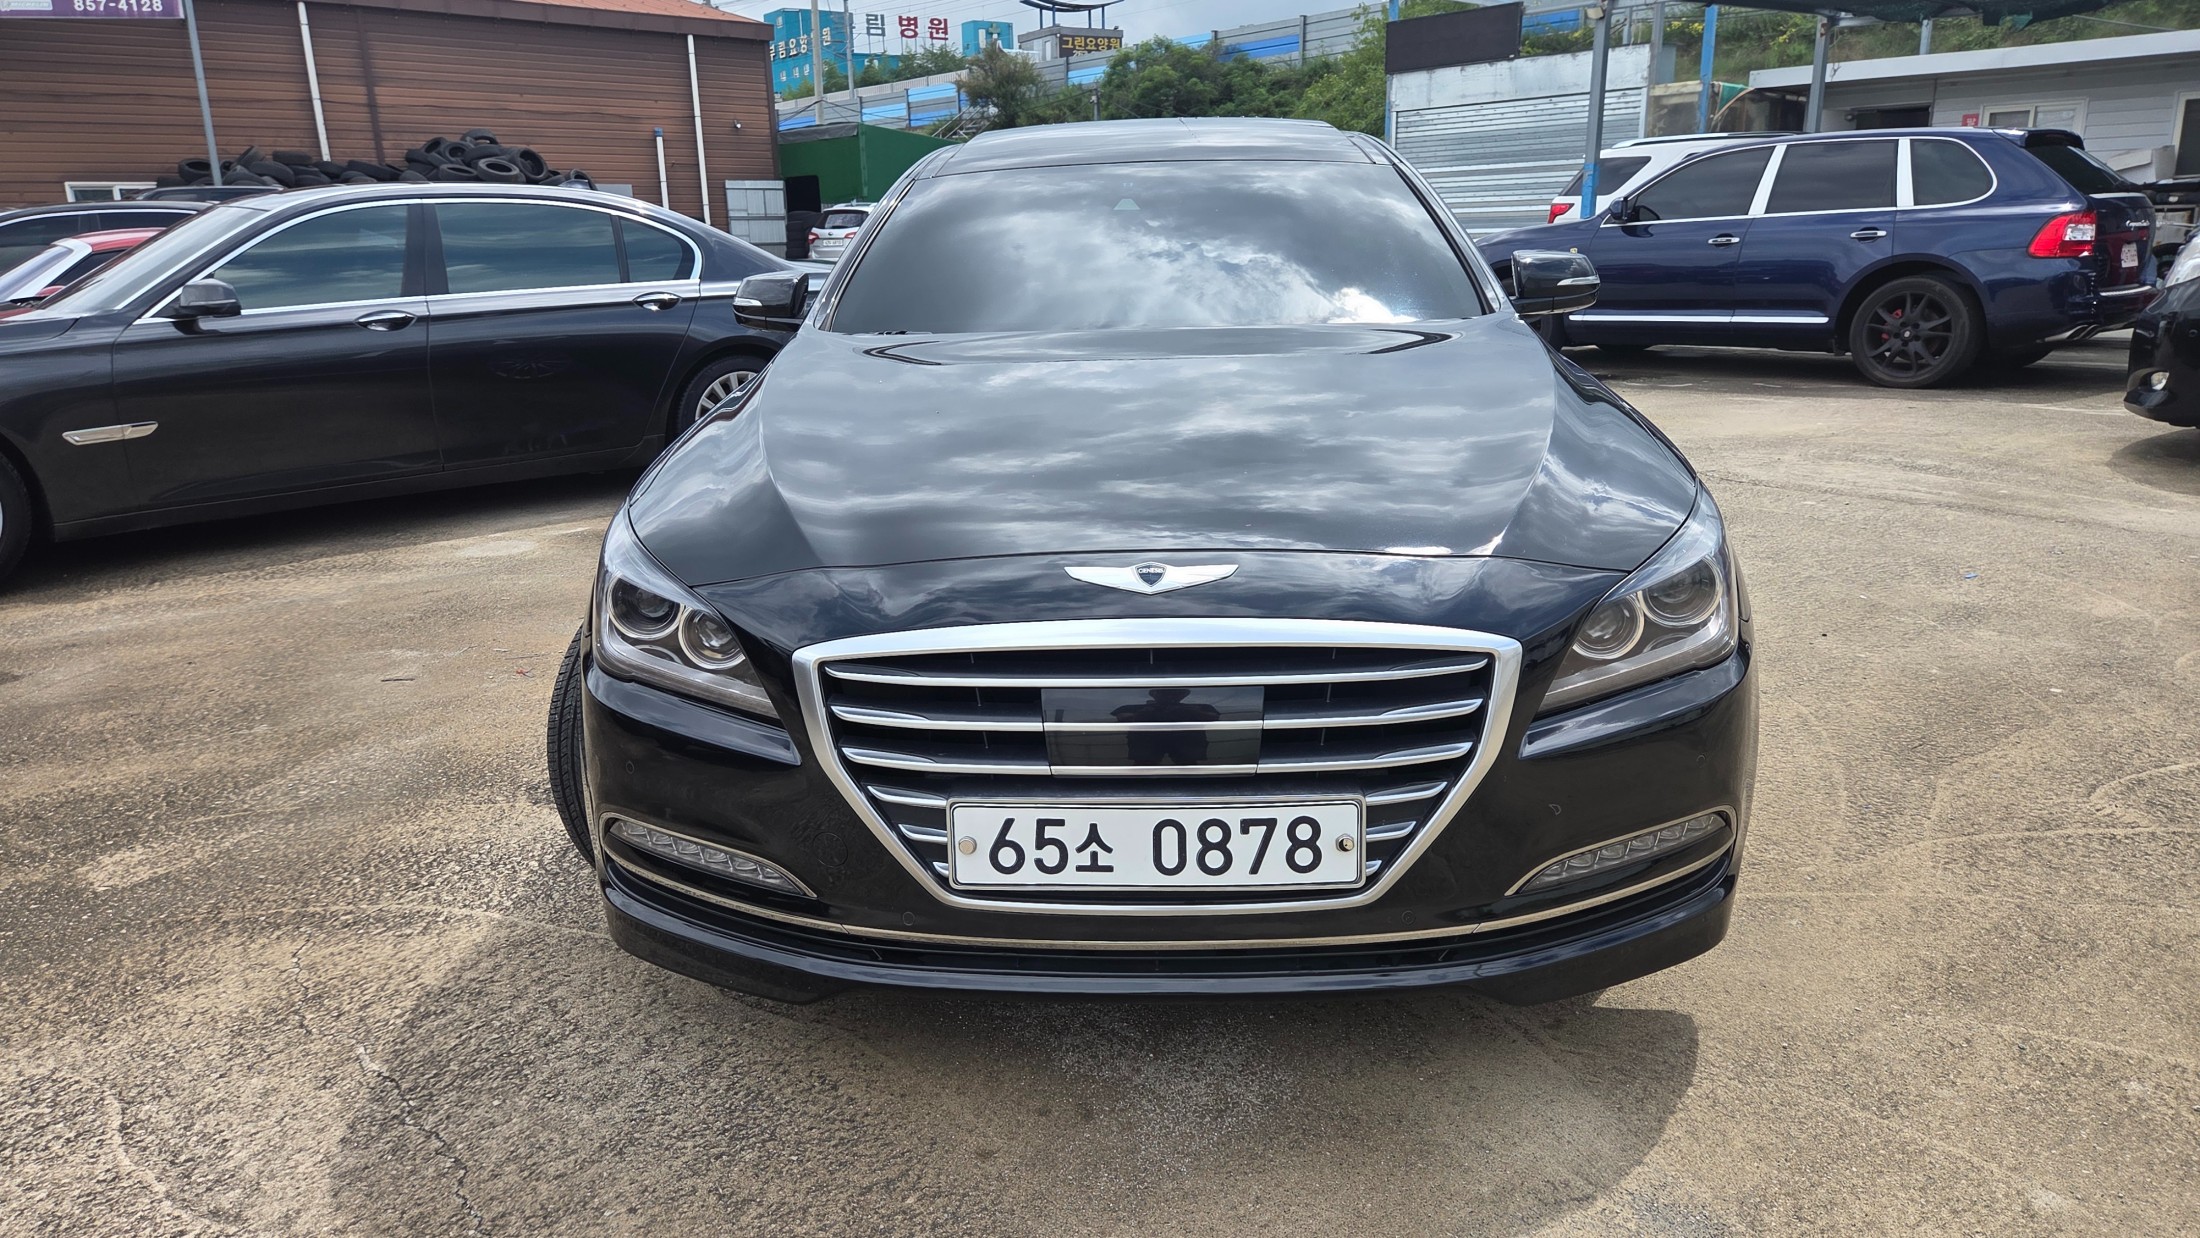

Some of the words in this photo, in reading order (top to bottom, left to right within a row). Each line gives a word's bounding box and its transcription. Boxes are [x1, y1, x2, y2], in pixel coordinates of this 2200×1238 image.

[73, 0, 163, 12] 857-4128
[988, 817, 1114, 876] 65소
[1152, 815, 1322, 876] 0878
